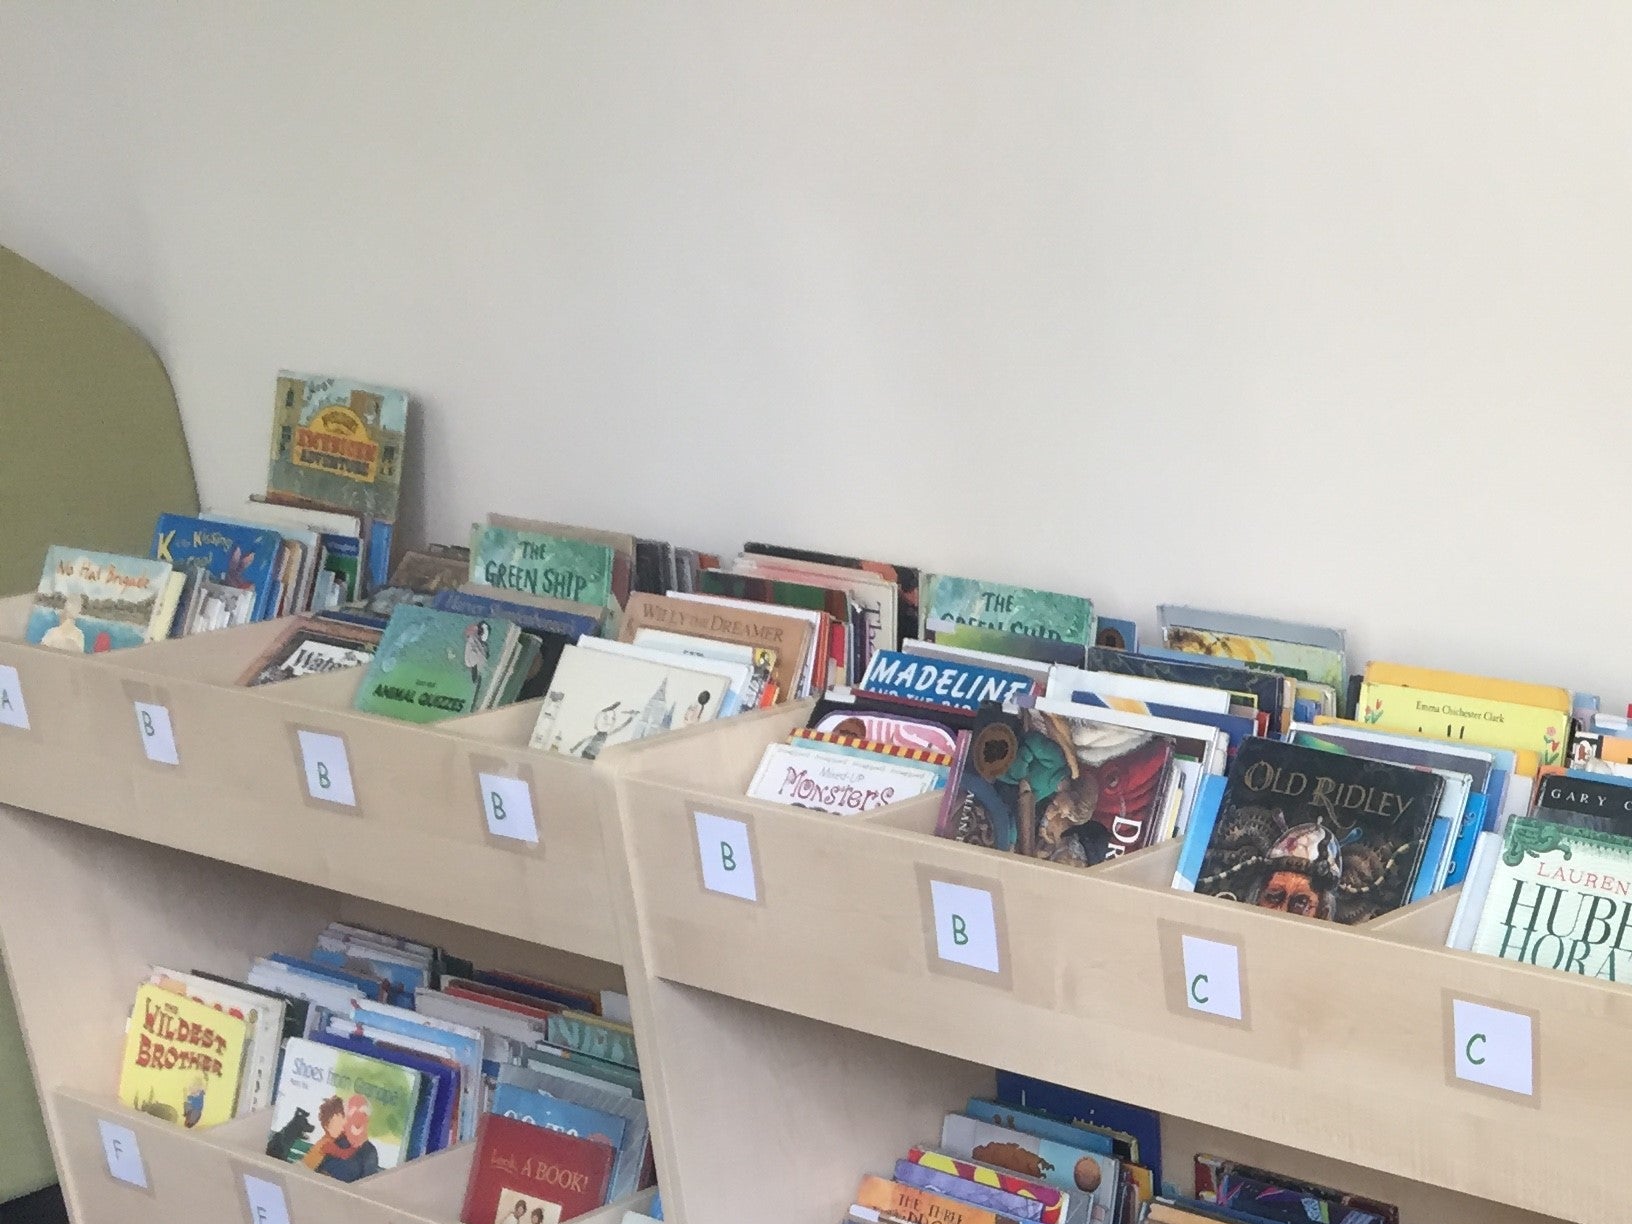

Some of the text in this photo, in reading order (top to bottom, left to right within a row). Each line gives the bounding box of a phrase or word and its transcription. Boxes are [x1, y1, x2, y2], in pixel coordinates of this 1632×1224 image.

[520, 540, 546, 560] THE
[485, 560, 588, 601] GREEN SHIP
[981, 591, 1015, 613] THE
[643, 602, 687, 623] WILLY
[710, 615, 784, 643] DREAMER
[869, 656, 1027, 704] MADELINE
[1, 688, 14, 711] A
[1416, 700, 1441, 713] Emma
[1483, 709, 1505, 724] Clark
[140, 711, 155, 737] B
[317, 762, 331, 790] B
[490, 791, 507, 821] B
[1550, 788, 1607, 807] GARY
[720, 840, 736, 872] B
[1536, 861, 1631, 896] LAUREN
[951, 913, 969, 946] B
[1191, 973, 1210, 1005] C
[142, 997, 228, 1055] WILDEST
[135, 1033, 224, 1079] BROTHER
[1465, 1032, 1487, 1066] C
[292, 1057, 324, 1084] Shoes
[112, 1138, 124, 1161] F
[535, 1161, 589, 1193] BOOK!
